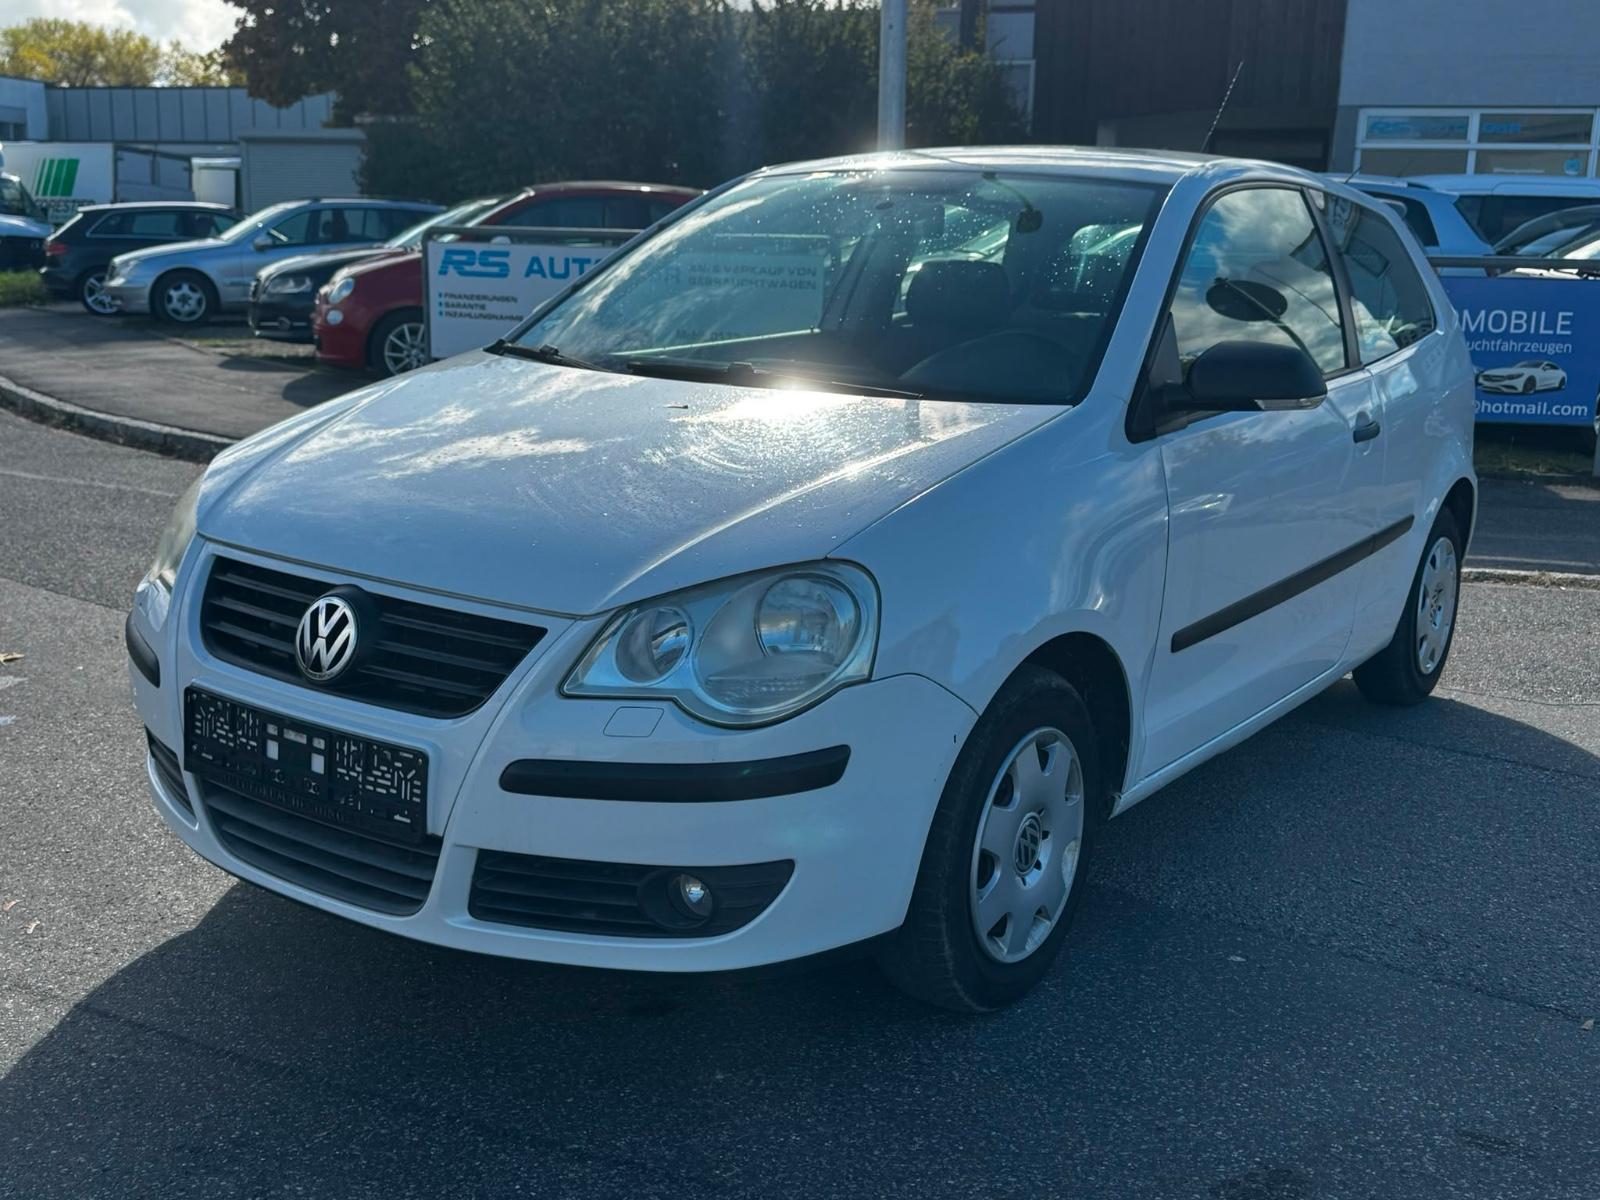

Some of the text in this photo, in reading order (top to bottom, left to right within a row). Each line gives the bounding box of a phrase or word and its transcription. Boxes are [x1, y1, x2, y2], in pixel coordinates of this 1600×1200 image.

[438, 249, 600, 279] RS AUT
[444, 292, 518, 303] FINANZIERUNGEN
[445, 302, 486, 311] GARANTIE
[1461, 309, 1574, 335] MOBILE
[1466, 339, 1572, 355] uchtfahrzeugen
[297, 597, 357, 680] VW
